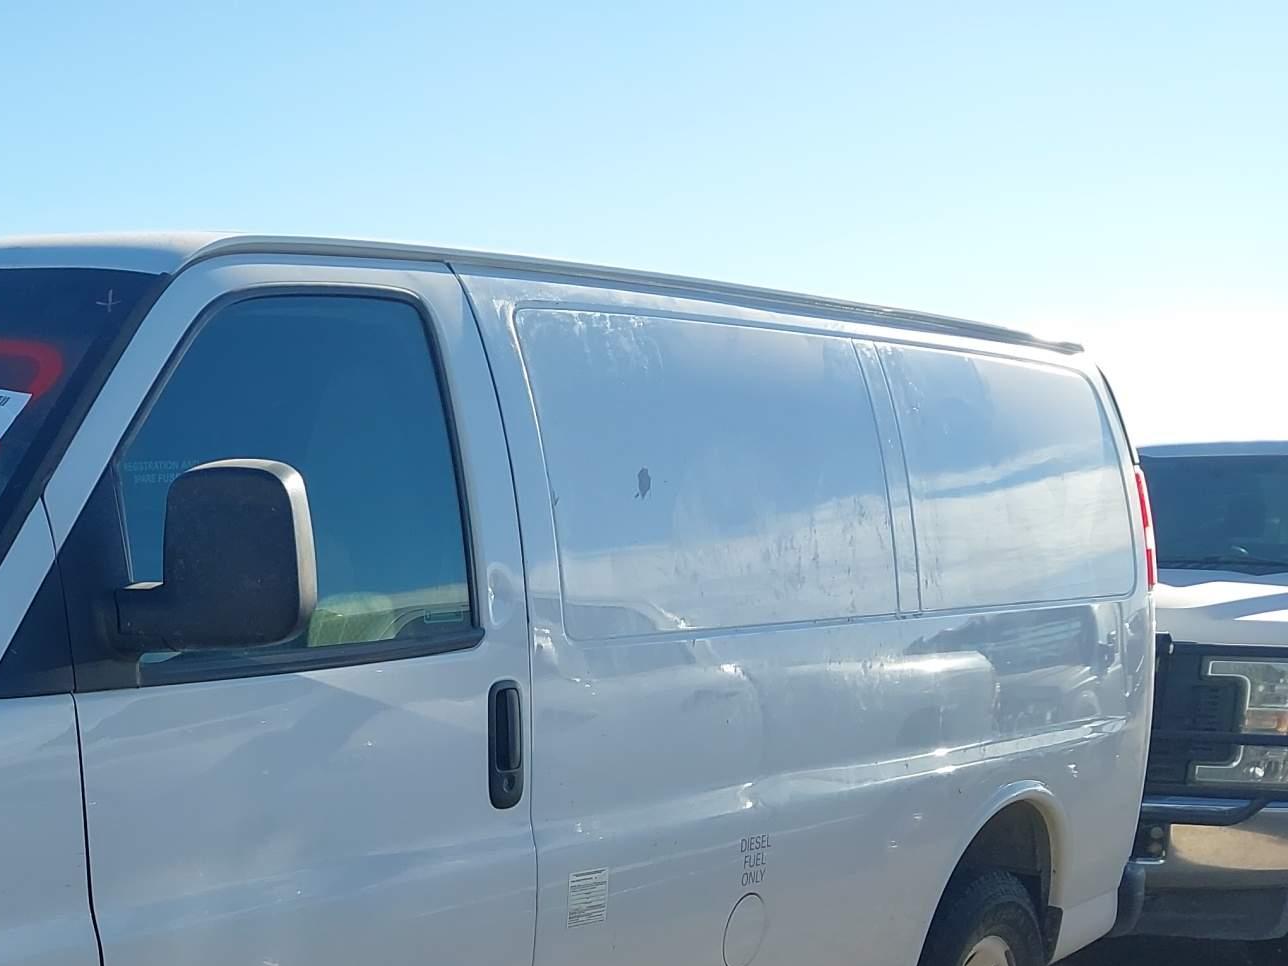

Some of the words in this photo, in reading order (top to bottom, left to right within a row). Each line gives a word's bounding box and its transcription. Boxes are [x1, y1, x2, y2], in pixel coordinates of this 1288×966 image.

[740, 834, 772, 853] DIESEL
[744, 852, 766, 869] FUEL
[742, 868, 766, 886] ONLY
